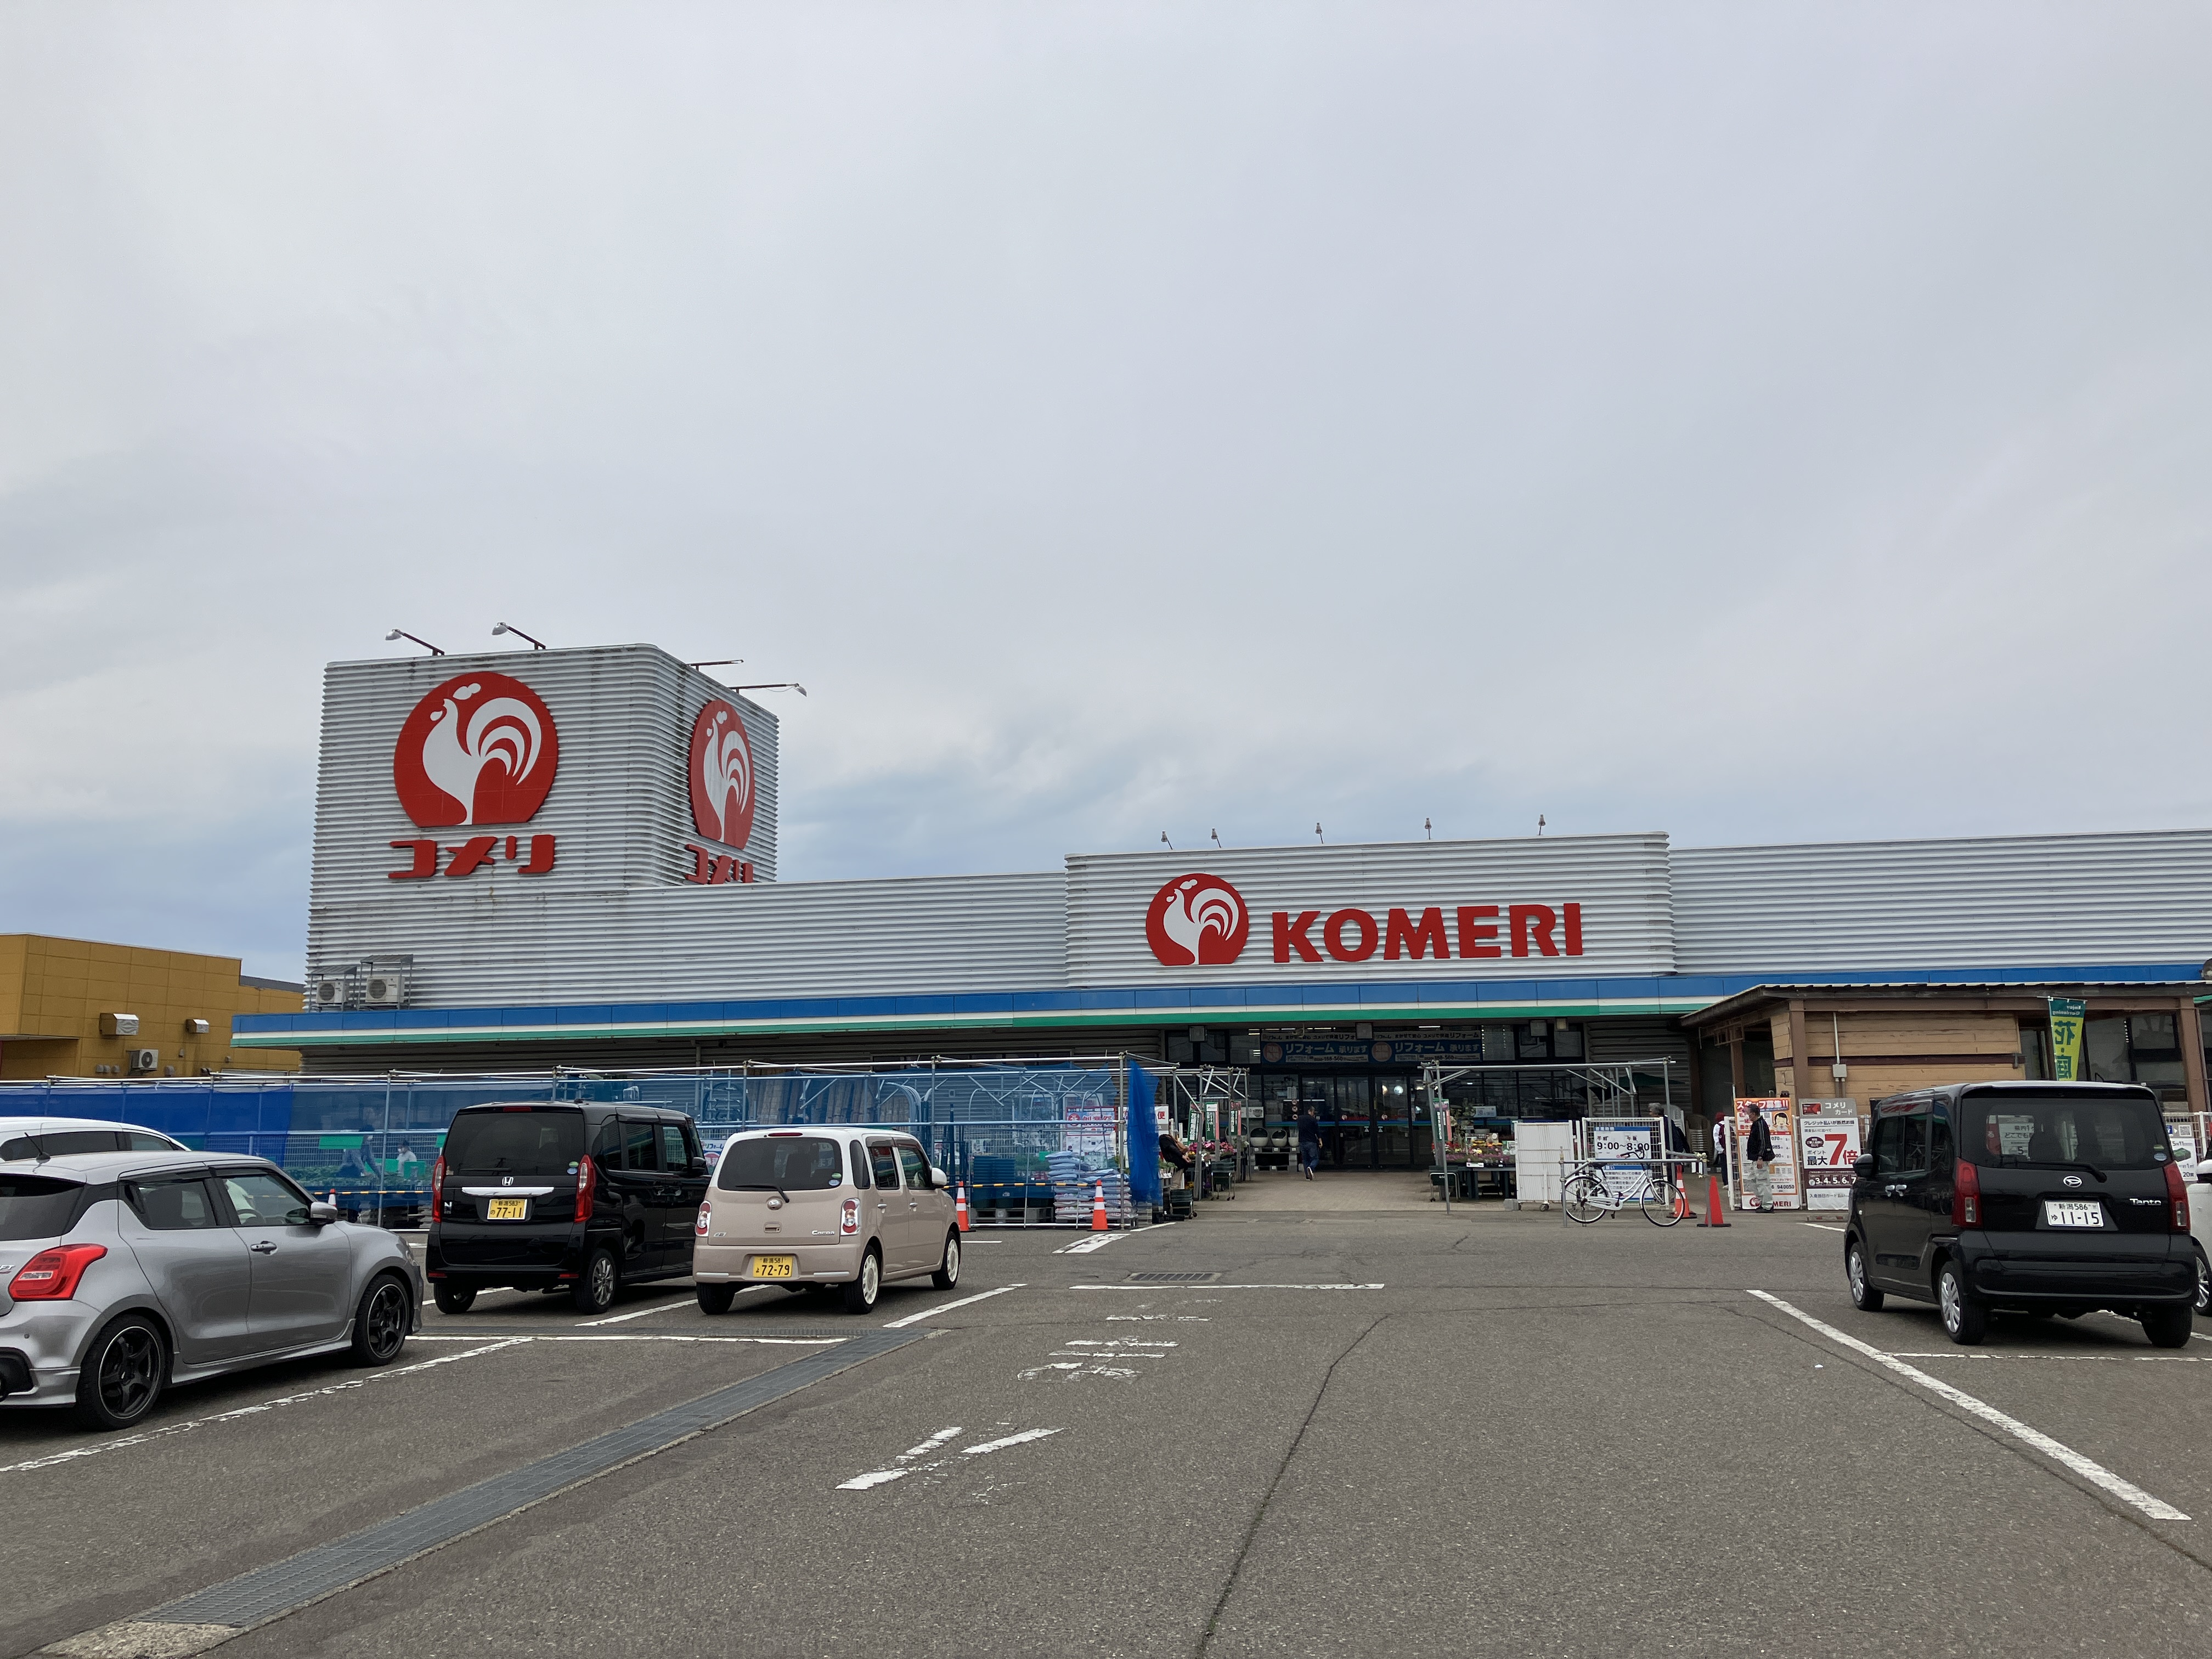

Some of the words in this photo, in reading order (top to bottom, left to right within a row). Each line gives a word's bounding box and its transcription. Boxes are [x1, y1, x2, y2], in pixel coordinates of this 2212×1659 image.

[388, 834, 555, 878] コメリ
[685, 844, 753, 884] コメリ
[1272, 902, 1583, 963] KOMERI
[1286, 1043, 1335, 1054] リフォーム
[1339, 1045, 1368, 1053] 承ります
[1395, 1042, 1445, 1053] リフォーム
[1449, 1044, 1480, 1052] 承ります
[1807, 1156, 1827, 1165] 最大
[496, 1207, 522, 1218] 77-11
[2061, 1212, 2100, 1224] 11-15
[761, 1265, 790, 1276] 72-79
